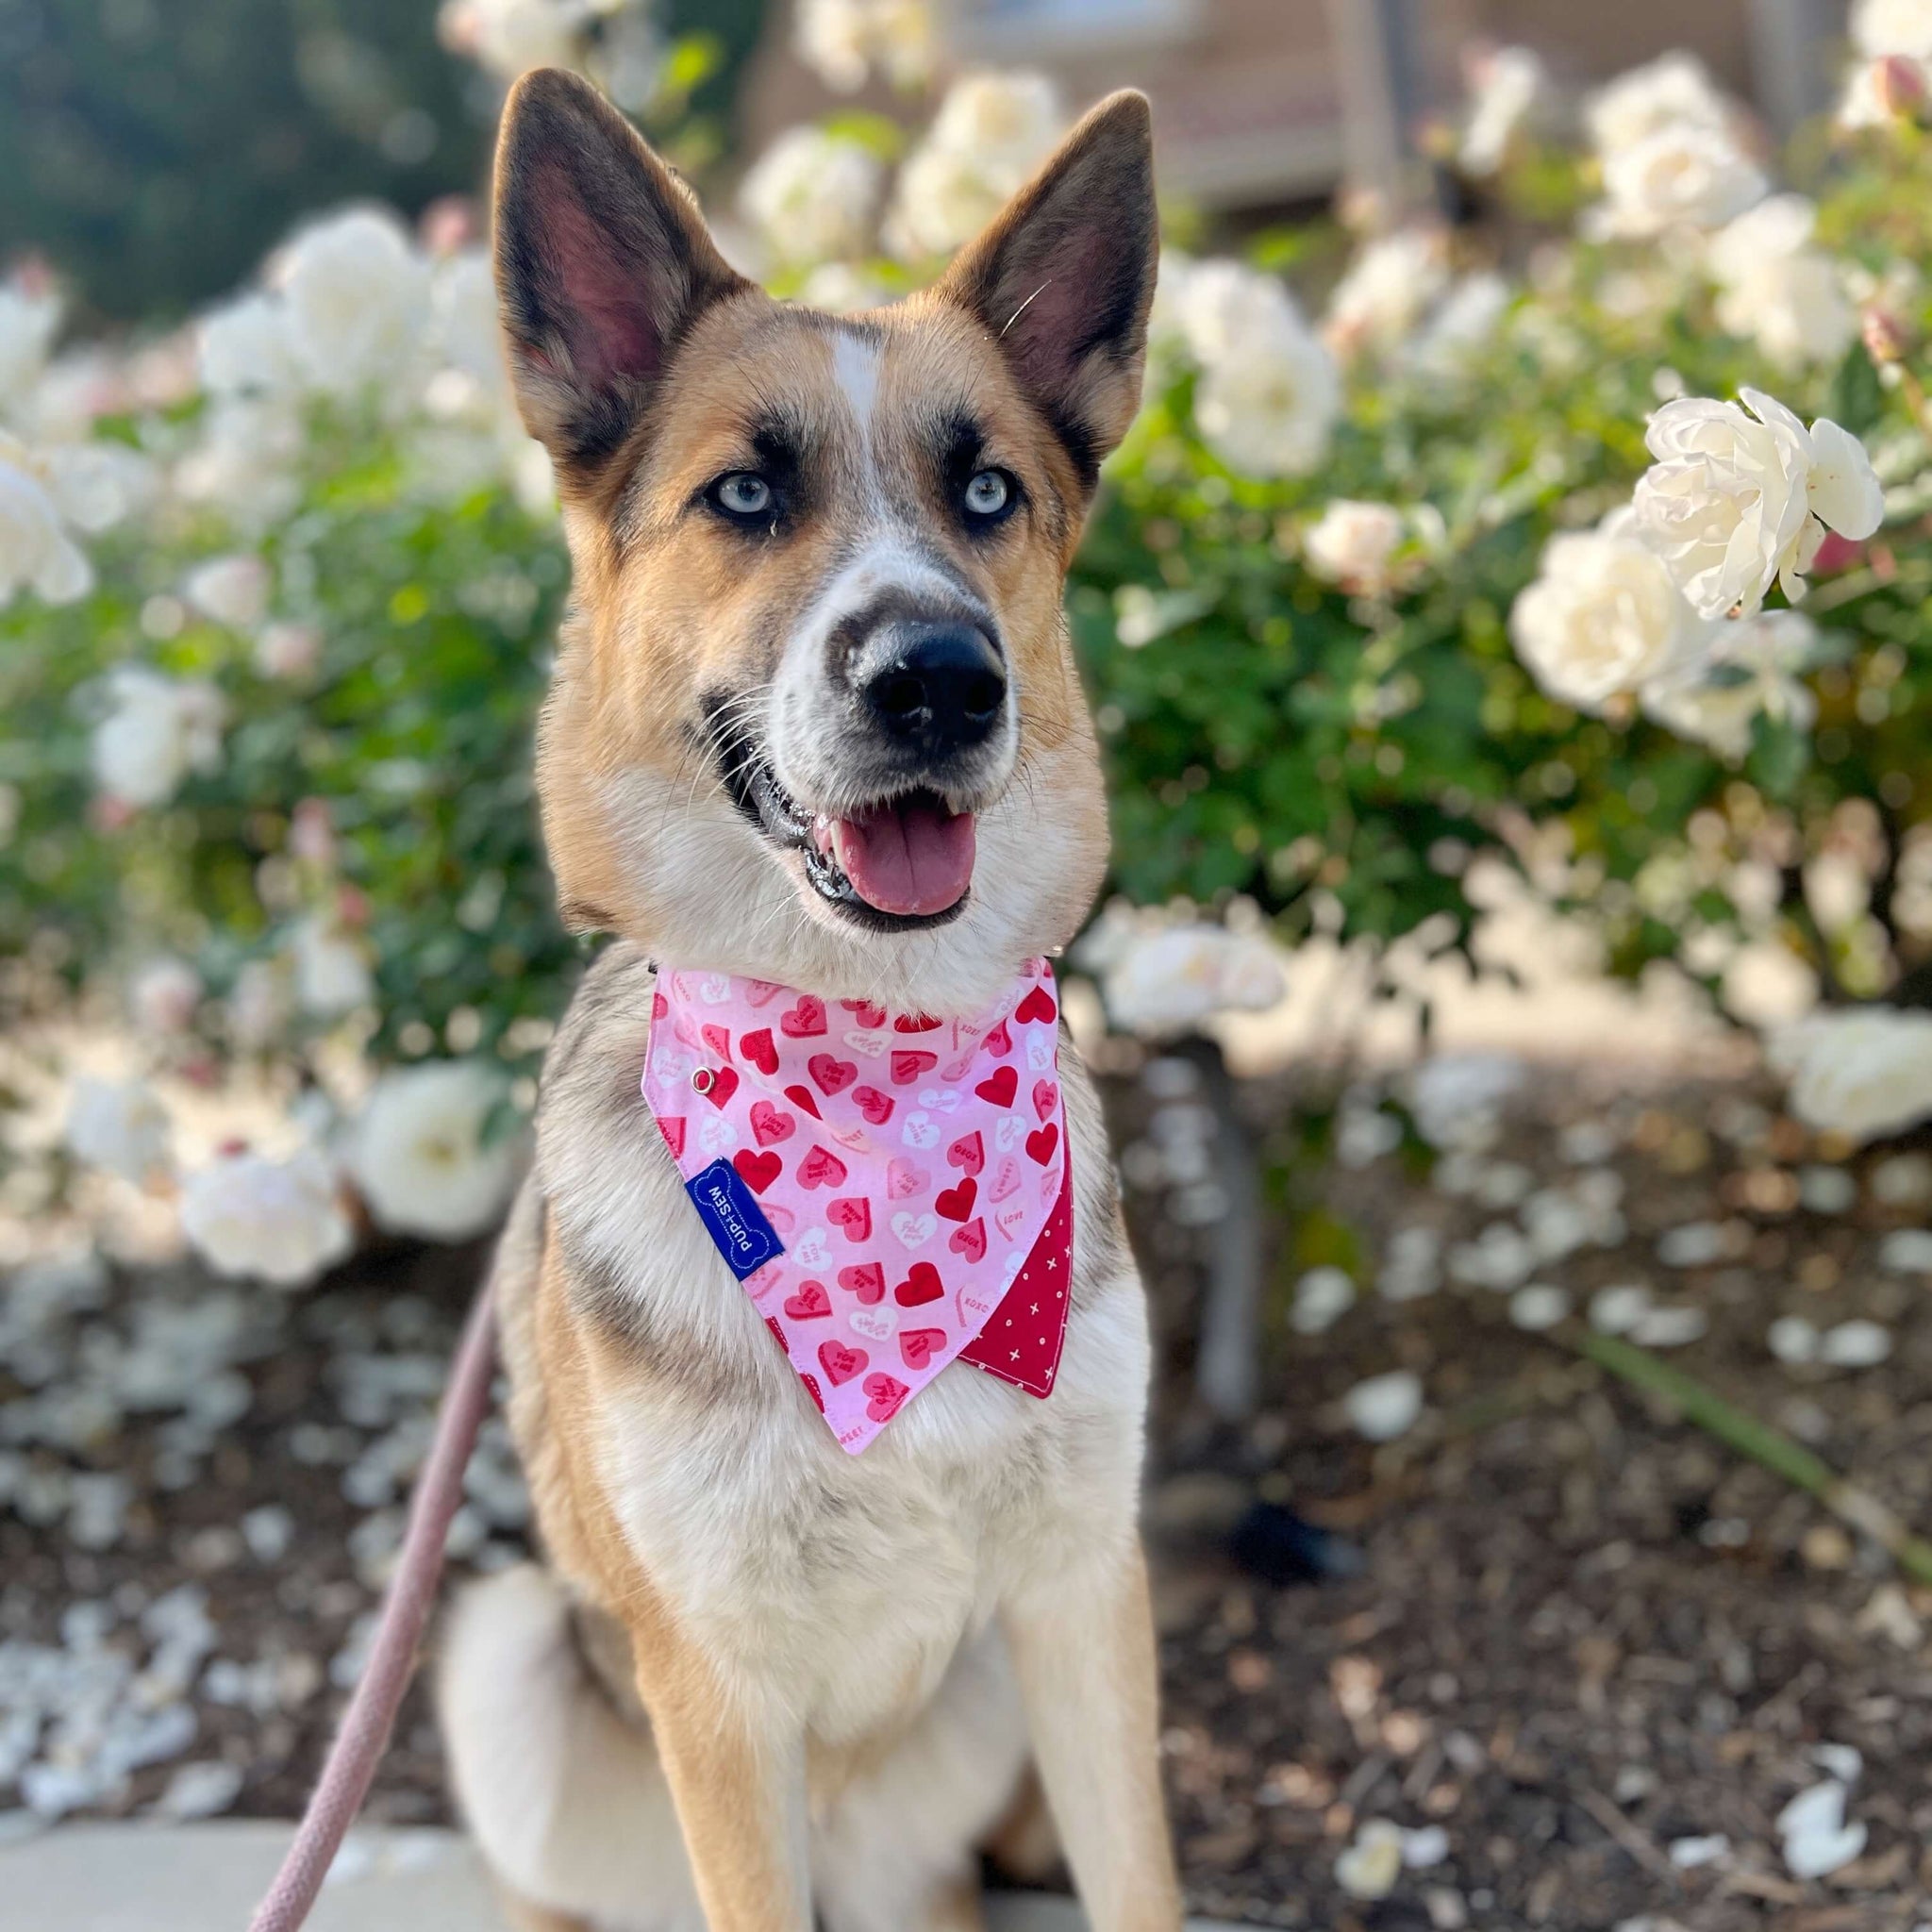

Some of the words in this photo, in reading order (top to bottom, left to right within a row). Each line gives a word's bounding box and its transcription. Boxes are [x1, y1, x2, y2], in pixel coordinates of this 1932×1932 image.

[955, 1144, 977, 1161] XOXO
[1004, 1210, 1024, 1224] LOVE
[958, 1231, 980, 1248] XOXO
